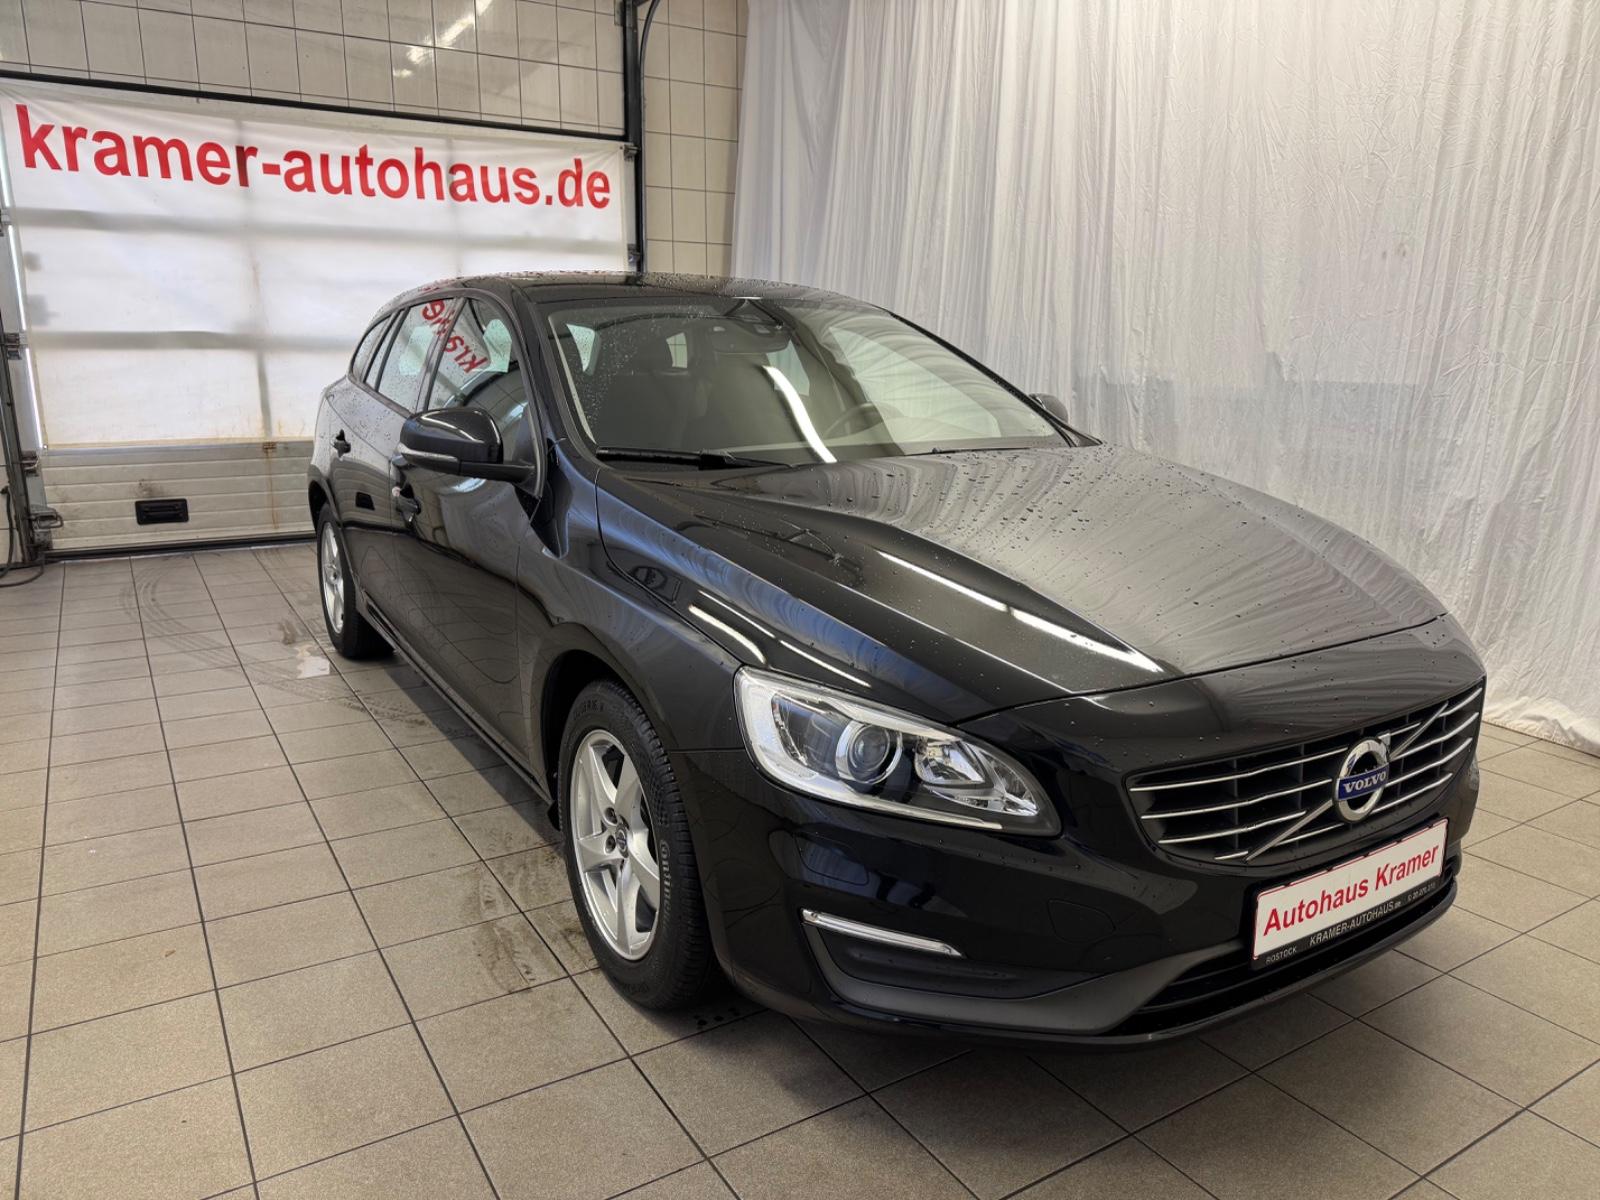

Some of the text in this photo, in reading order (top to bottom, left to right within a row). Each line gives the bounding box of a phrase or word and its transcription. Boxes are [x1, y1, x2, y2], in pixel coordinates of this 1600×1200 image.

[16, 104, 610, 209] kramer-autohaus.de
[1343, 771, 1386, 793] VOLVO
[1263, 879, 1369, 936] Autohaus
[1375, 846, 1439, 890] Kramer
